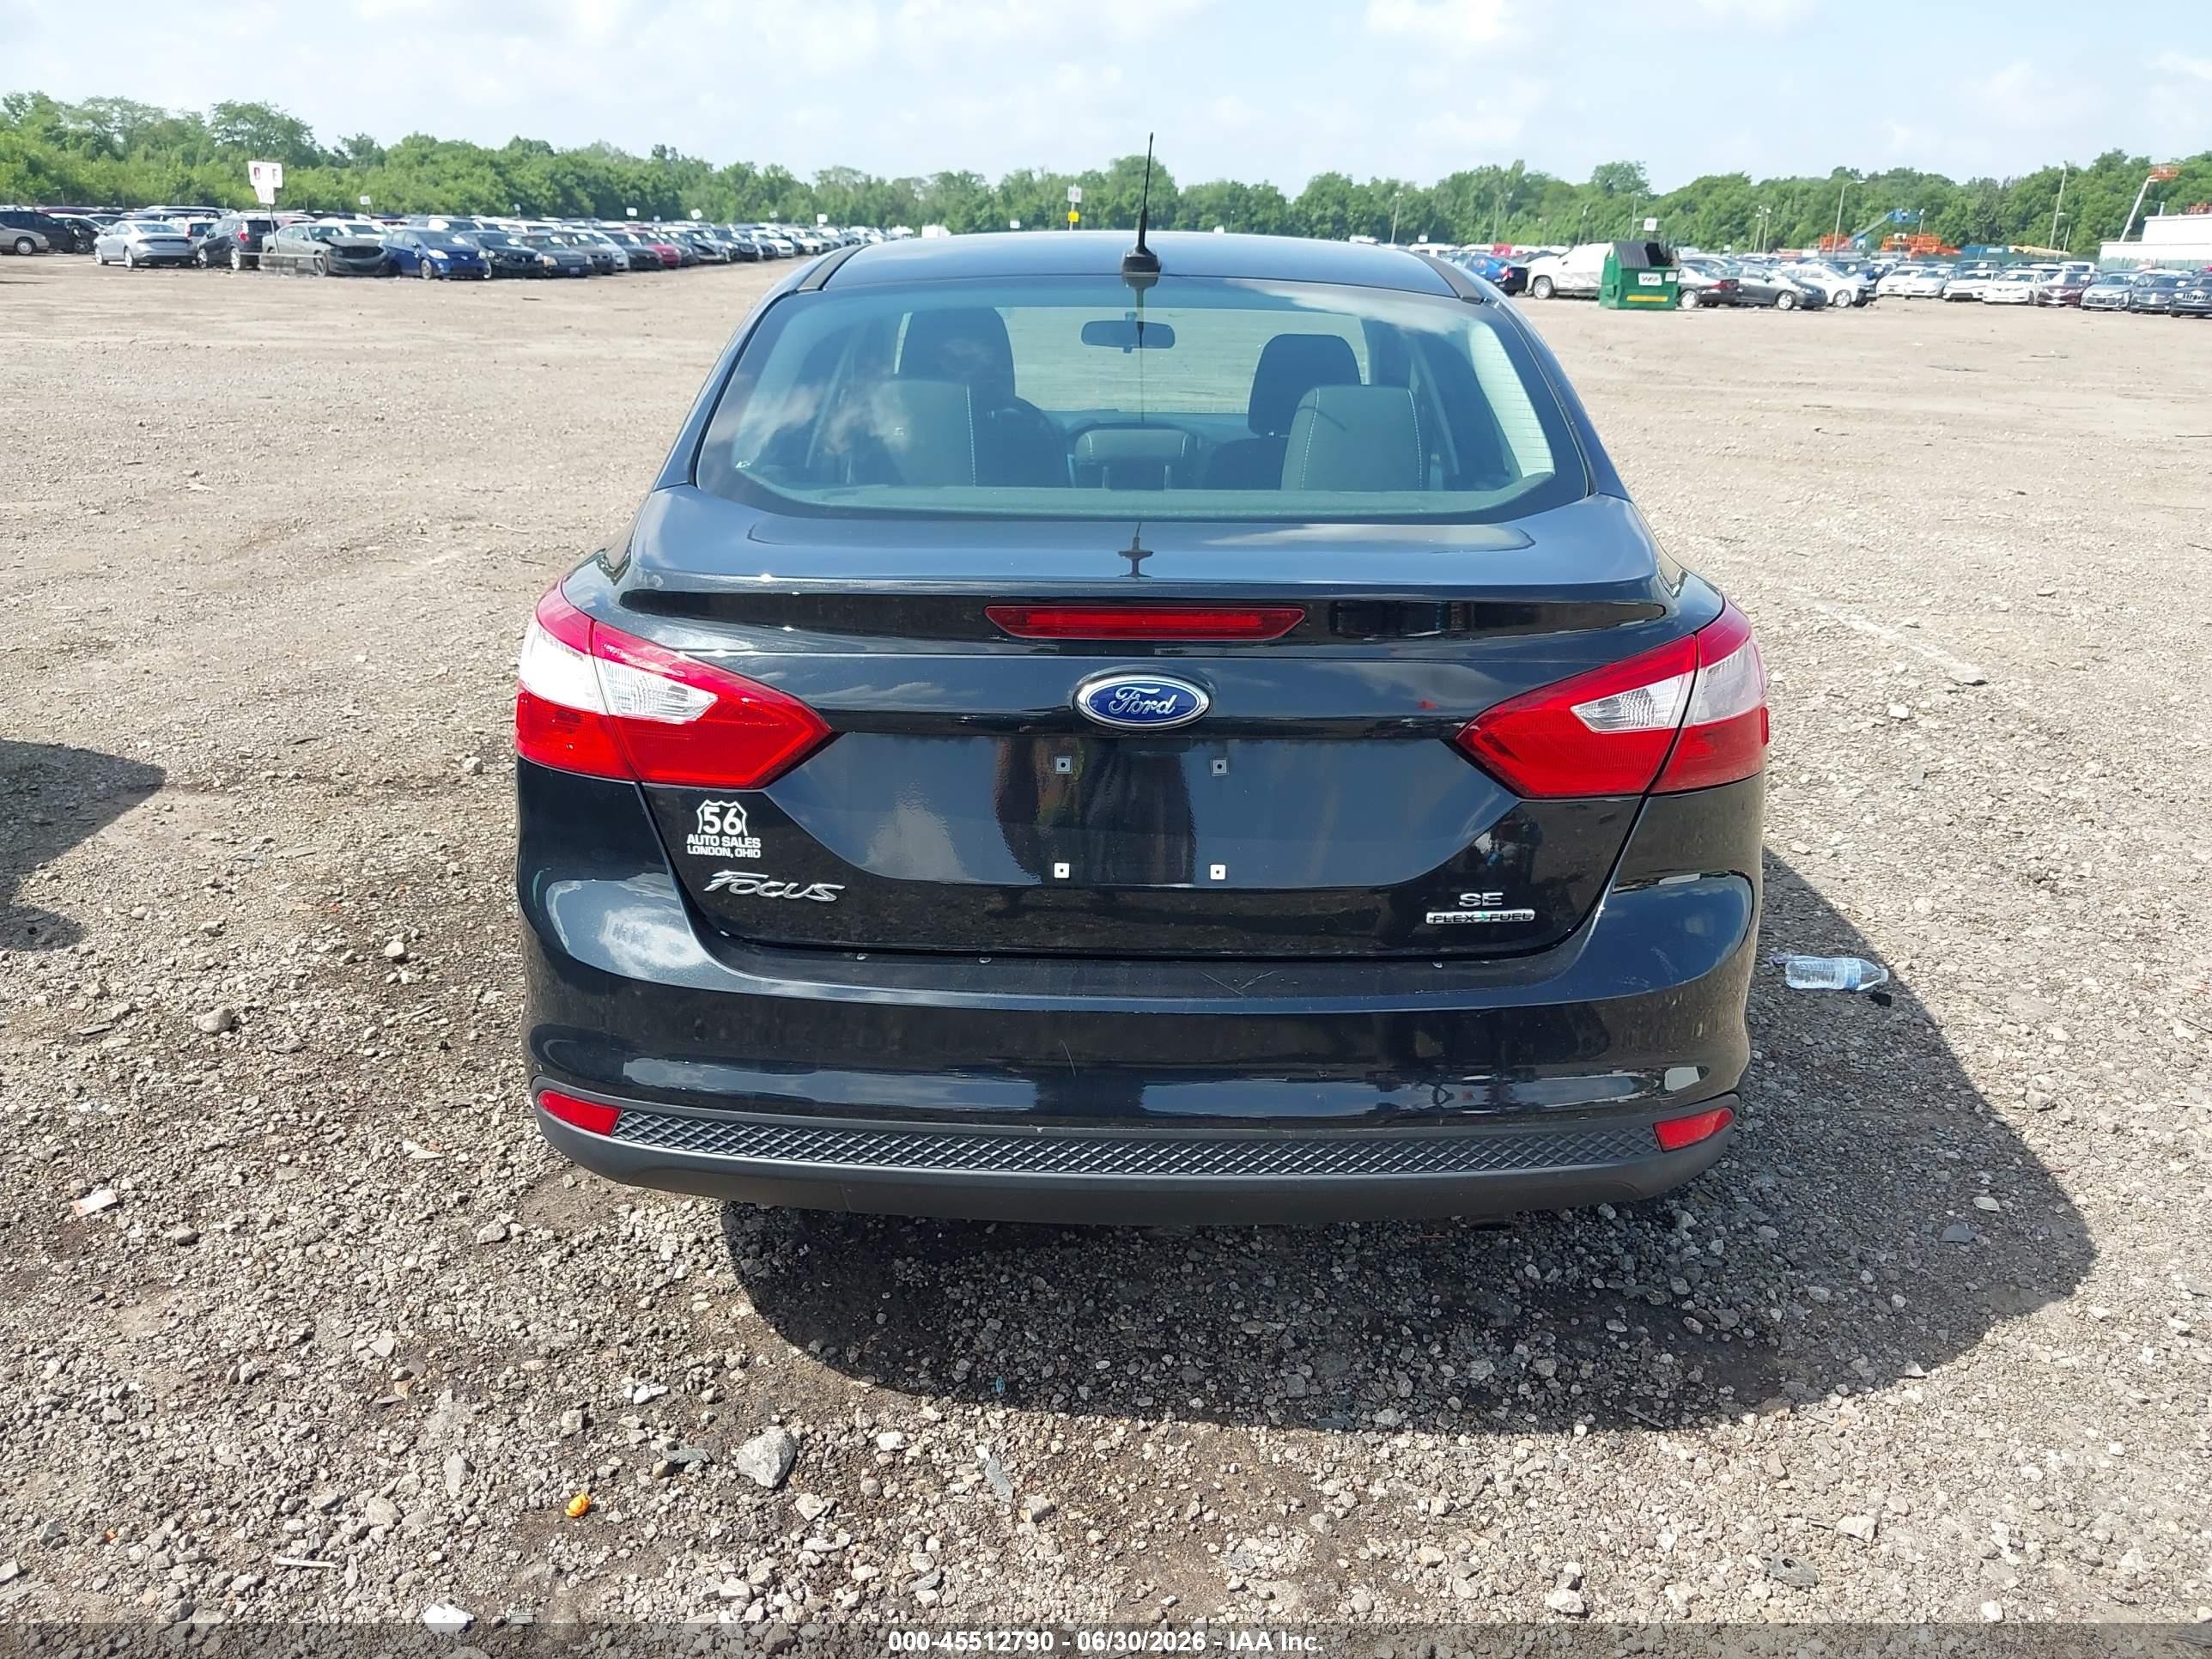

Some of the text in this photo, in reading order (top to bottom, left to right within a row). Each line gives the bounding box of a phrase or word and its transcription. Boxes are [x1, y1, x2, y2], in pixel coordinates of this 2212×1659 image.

[1108, 685, 1178, 715] Ford
[702, 806, 743, 836] 56
[686, 834, 762, 849] AUTO SALES
[687, 845, 762, 859] LONDON, OHIO
[1458, 891, 1504, 908] SE
